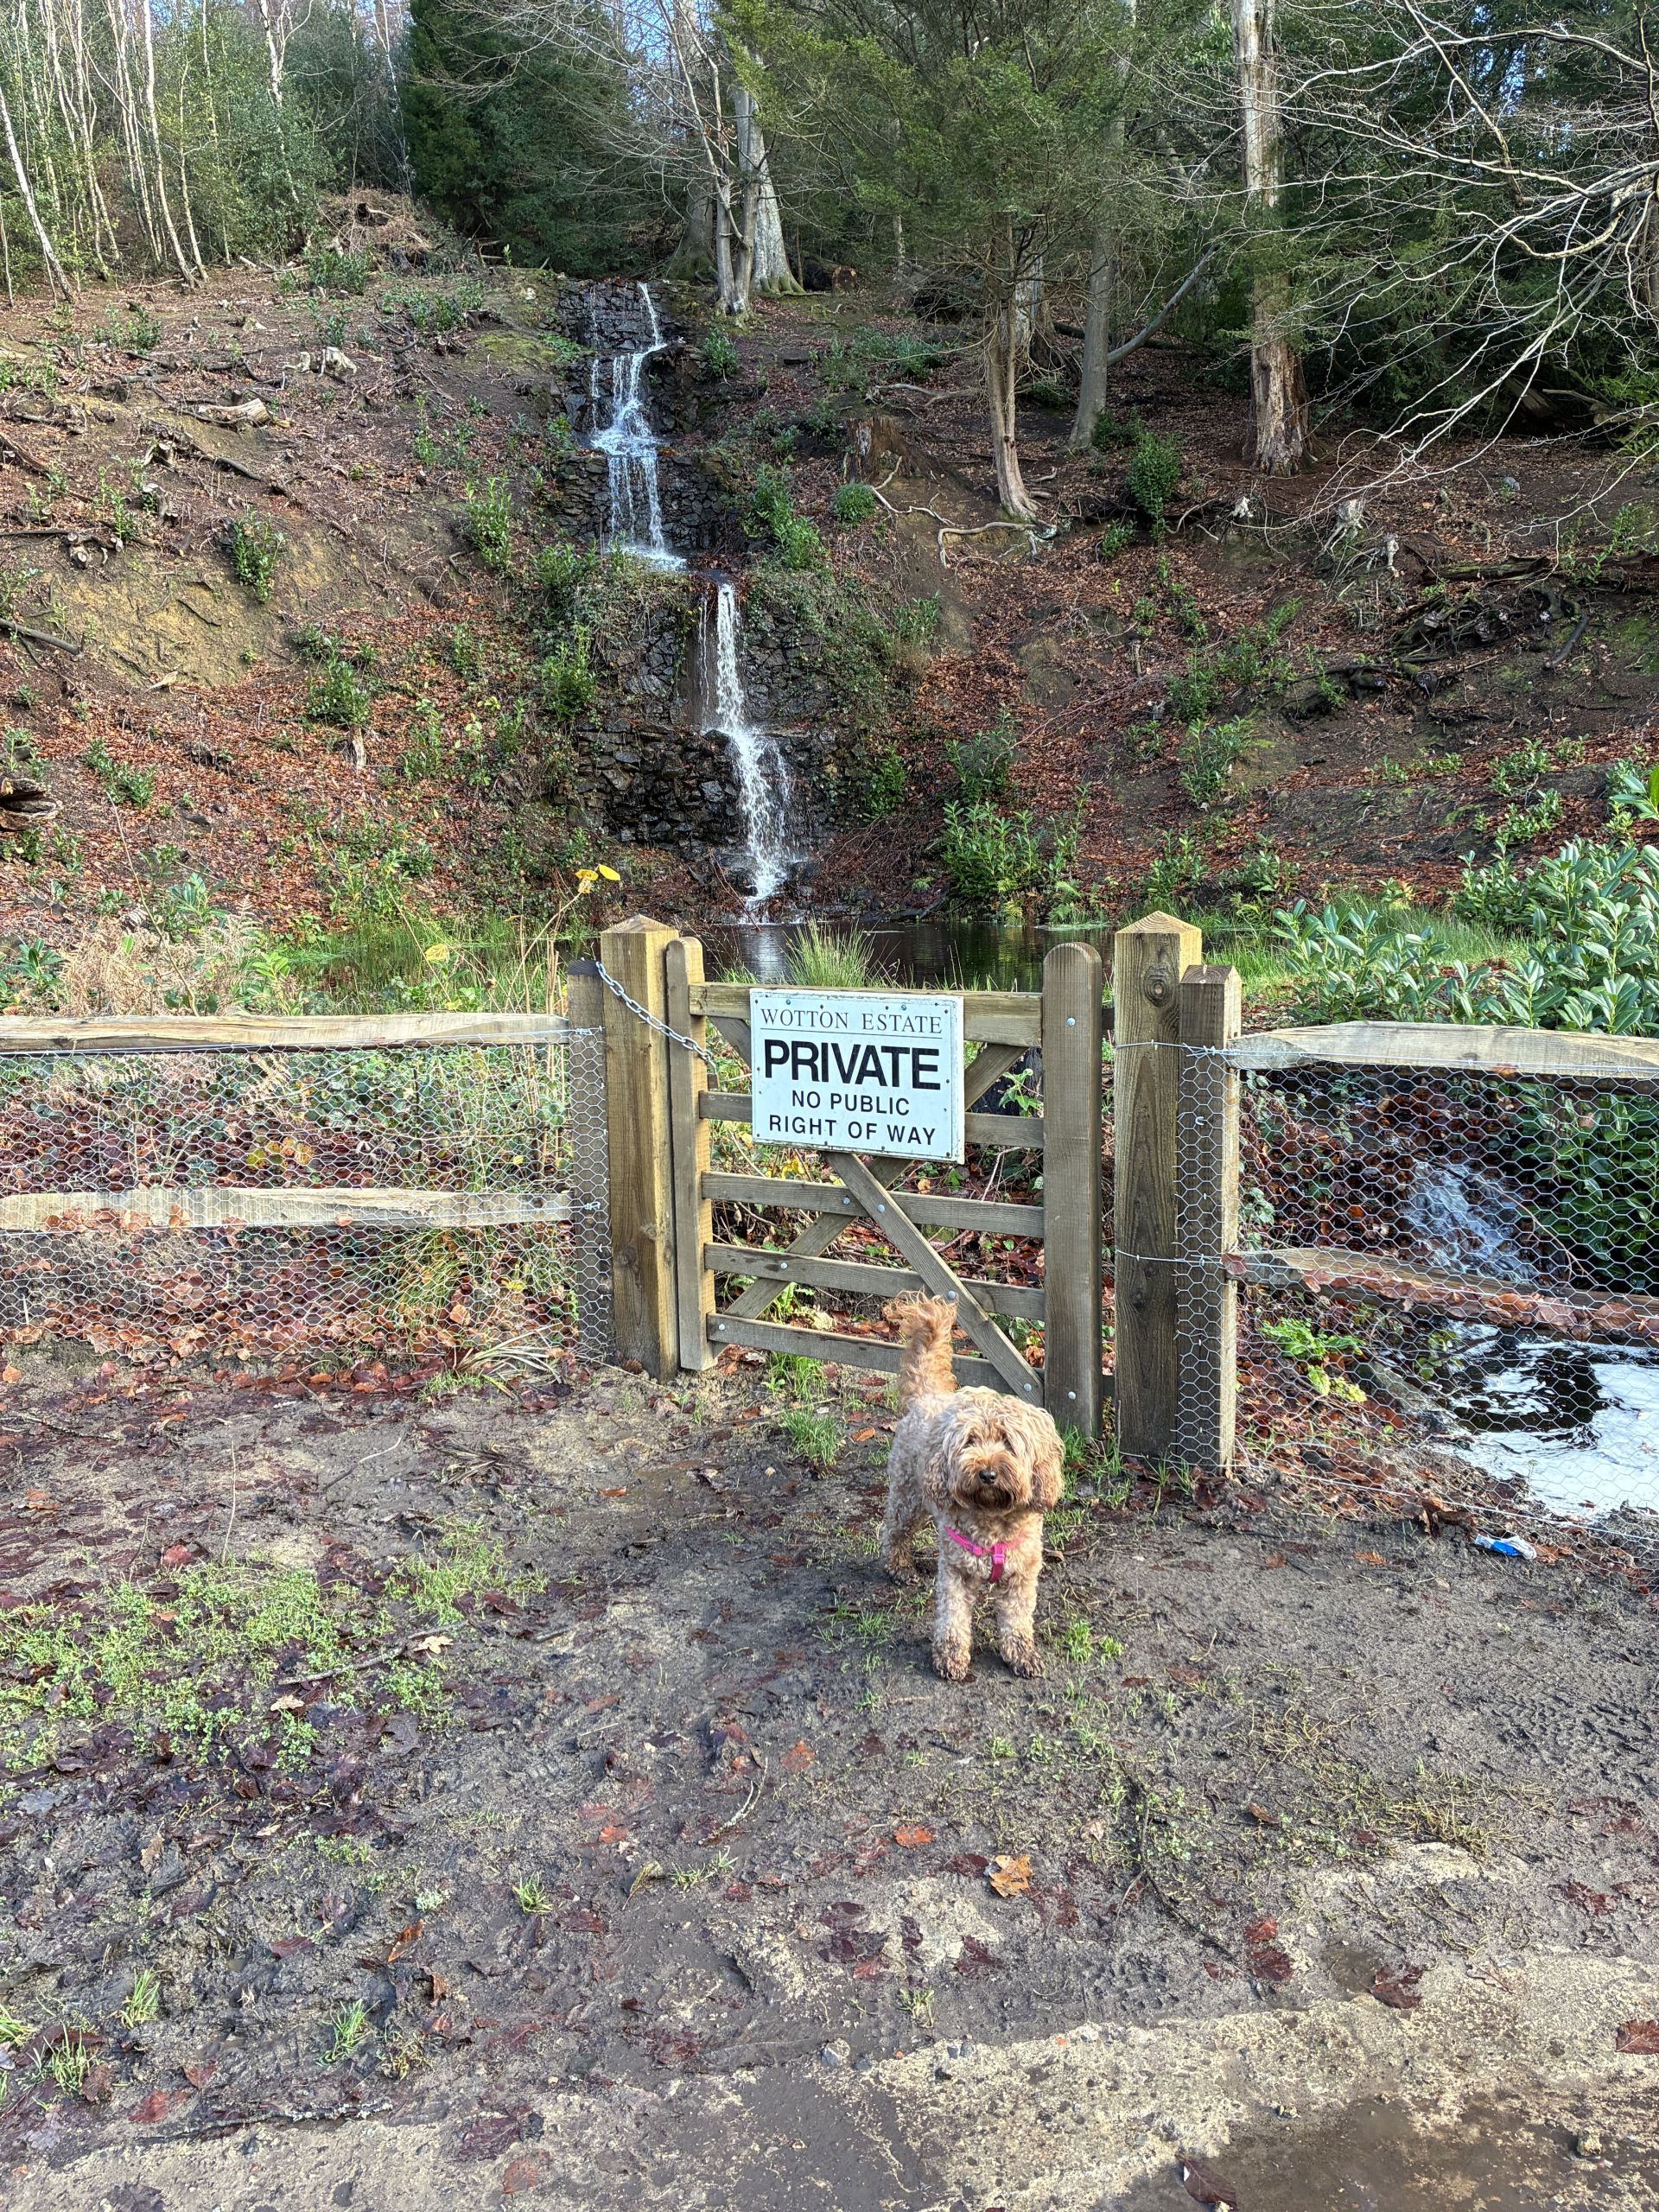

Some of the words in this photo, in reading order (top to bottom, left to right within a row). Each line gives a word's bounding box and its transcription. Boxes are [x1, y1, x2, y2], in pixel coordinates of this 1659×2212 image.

[760, 1008, 849, 1029] WOTTON
[862, 1013, 942, 1033] ESTATE
[764, 1039, 941, 1090] PRIVATE
[791, 1090, 821, 1109] NO
[830, 1092, 910, 1116] PUBLIC
[769, 1115, 836, 1136] RIGHT
[848, 1121, 877, 1140] OF
[887, 1124, 936, 1145] WAY
